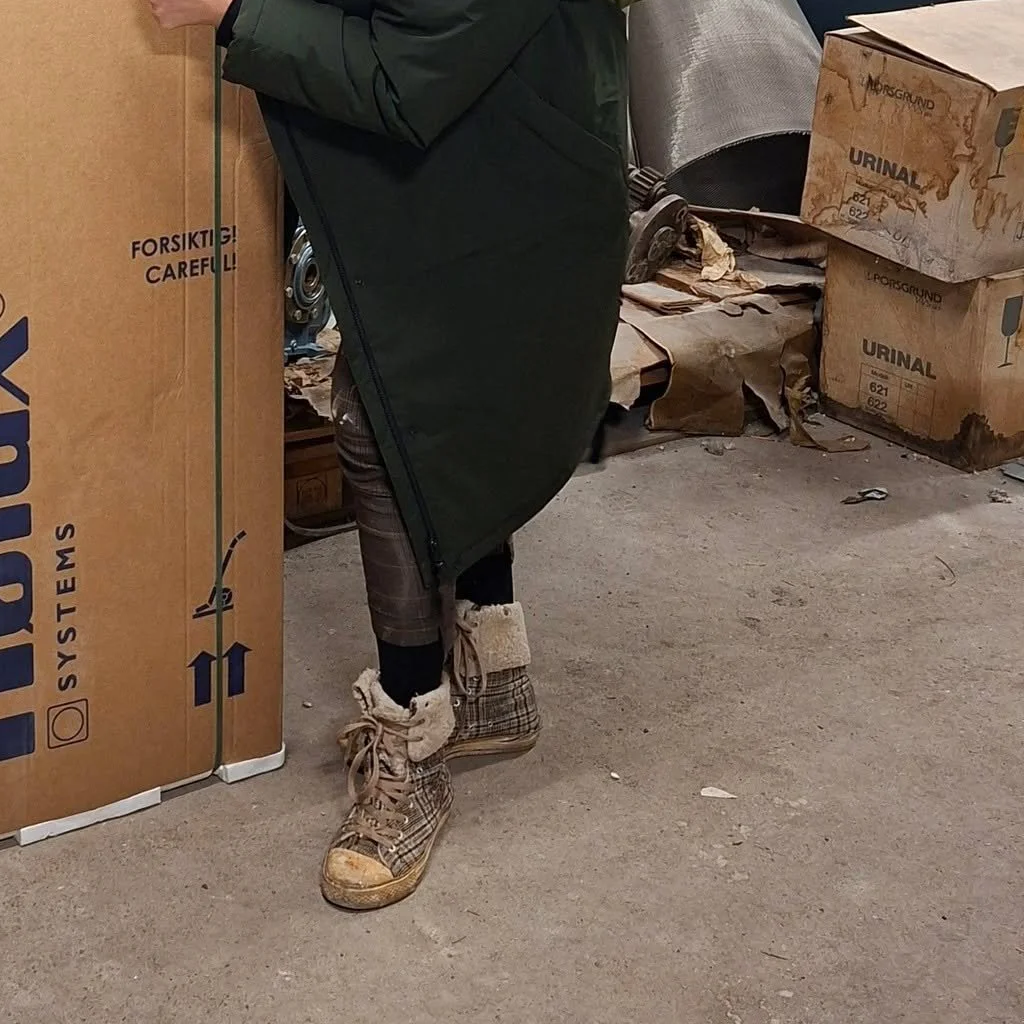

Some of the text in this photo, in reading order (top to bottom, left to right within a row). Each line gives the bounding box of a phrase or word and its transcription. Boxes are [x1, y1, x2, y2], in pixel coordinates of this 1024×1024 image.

[849, 146, 922, 190] URINAL
[848, 206, 869, 220] 622
[131, 225, 237, 260] FORSIKTIG!
[873, 273, 943, 304] PORSGRUND
[862, 337, 937, 381] URINAL
[867, 396, 888, 413] 622
[869, 381, 889, 398] 621
[54, 521, 78, 692] SYSTEMS
